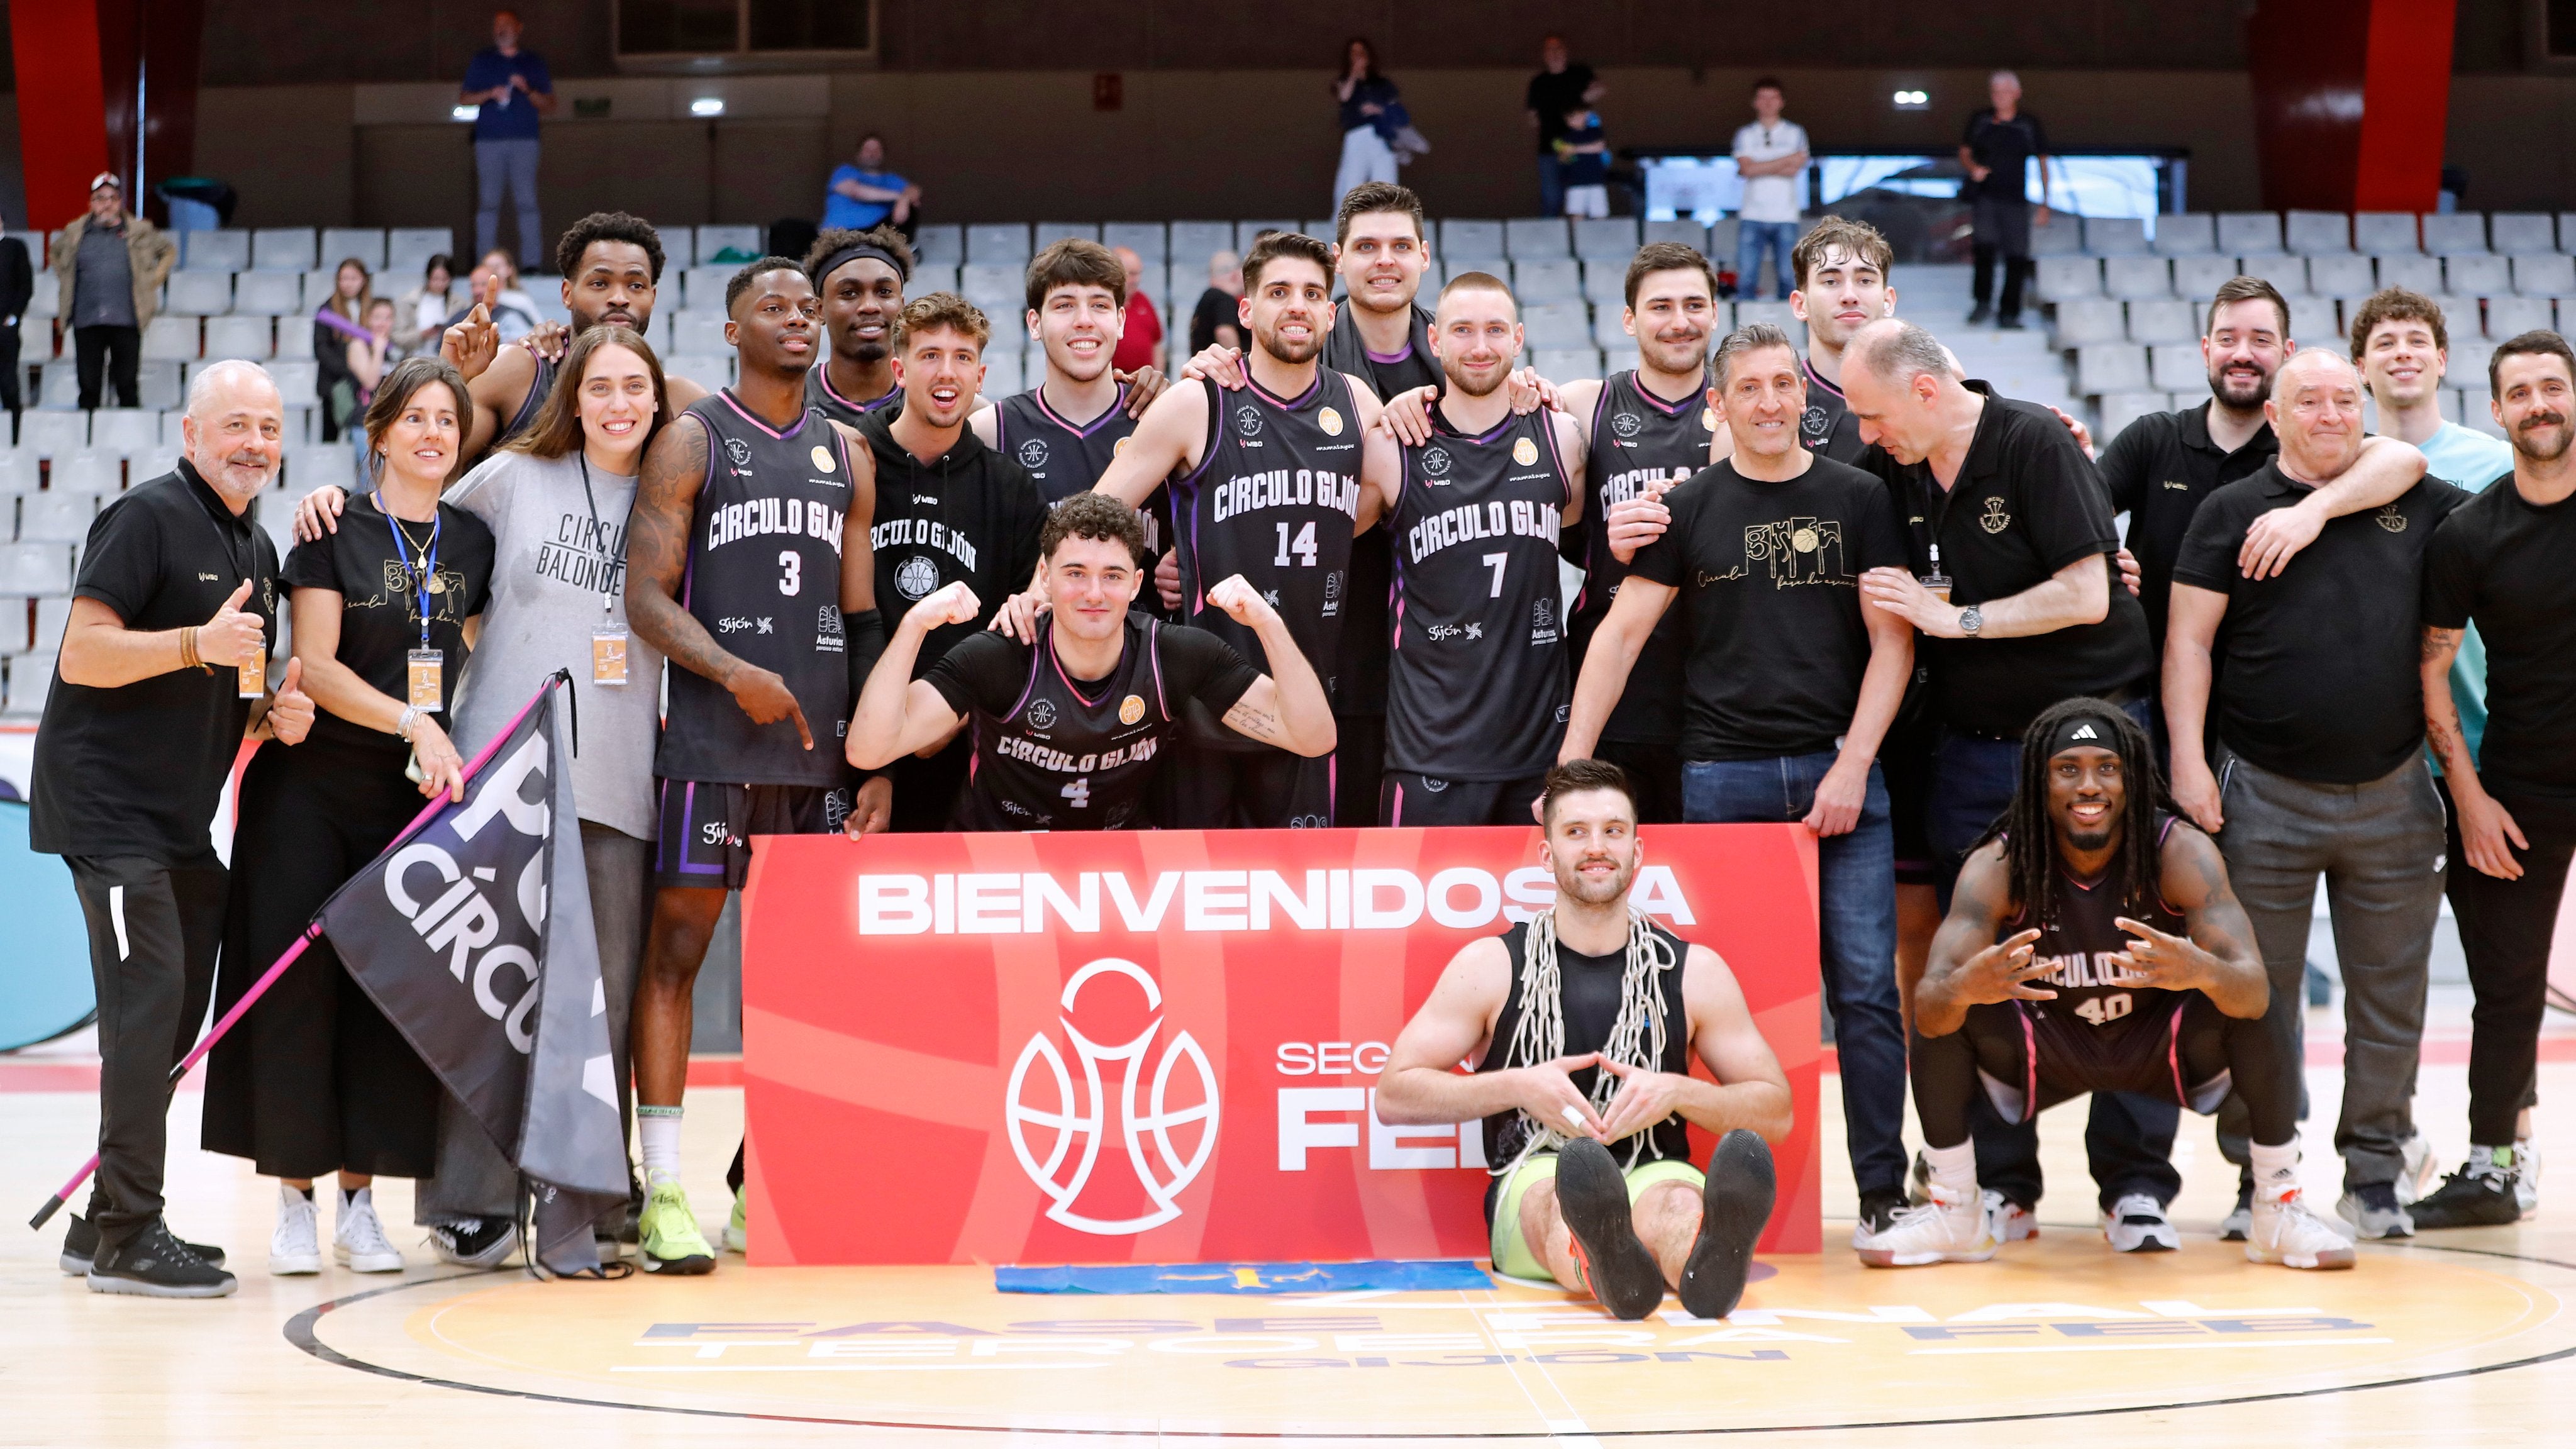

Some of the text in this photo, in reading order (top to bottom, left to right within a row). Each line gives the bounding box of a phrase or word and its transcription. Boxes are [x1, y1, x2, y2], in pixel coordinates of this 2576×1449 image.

[1214, 469, 1312, 523] CÍRCULO
[708, 497, 844, 560] CÍRCULO GIJÓ
[1274, 521, 1318, 567] 14
[1409, 501, 1507, 565] CÍRCULO
[779, 550, 801, 597] 3
[1482, 552, 1509, 598] 7
[718, 615, 753, 634] gijón
[816, 634, 843, 647] Asturias
[1428, 624, 1462, 641] gijón
[997, 735, 1098, 773] CÍRCULO
[1061, 777, 1090, 808] 4
[2074, 992, 2133, 1026] 40
[640, 1316, 1384, 1338] FASE
[1899, 1317, 2379, 1341] FEB
[1221, 1348, 1792, 1370] GIJÓN
